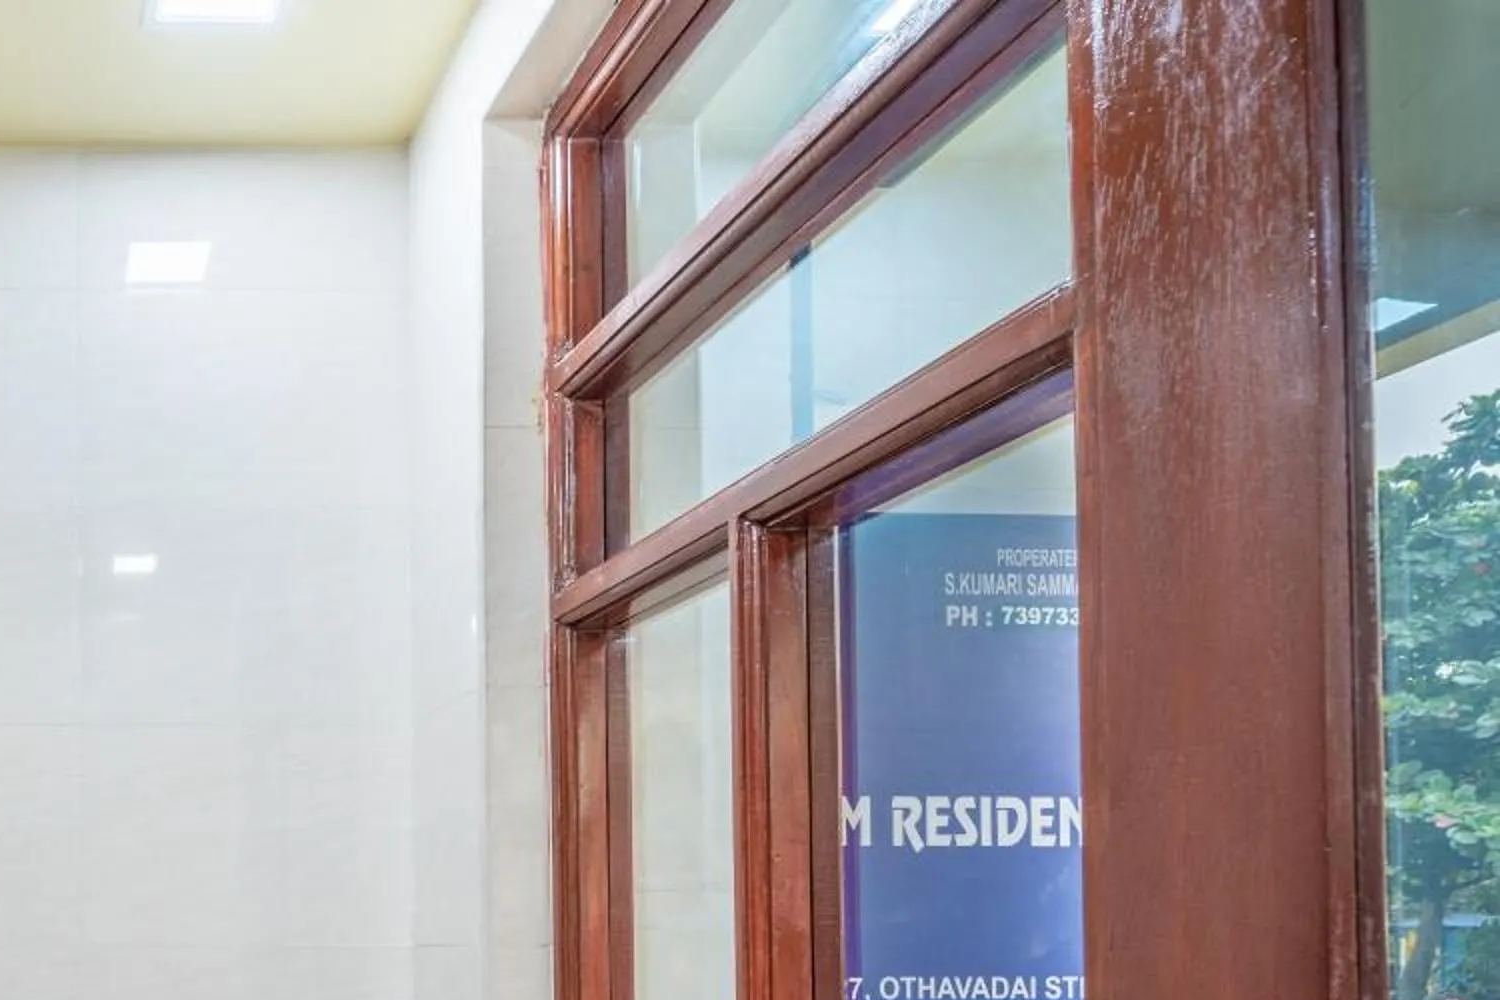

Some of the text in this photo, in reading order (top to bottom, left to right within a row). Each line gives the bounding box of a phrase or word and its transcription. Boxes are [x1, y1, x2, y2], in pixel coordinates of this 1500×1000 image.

[997, 549, 1077, 567] PROPERATE
[945, 573, 1079, 597] S.KUMARI SAMM
[946, 605, 978, 627] PH
[1001, 606, 1080, 625] 739733
[892, 796, 1083, 853] RESIDEN
[879, 975, 1037, 1000] OTHAVADAI
